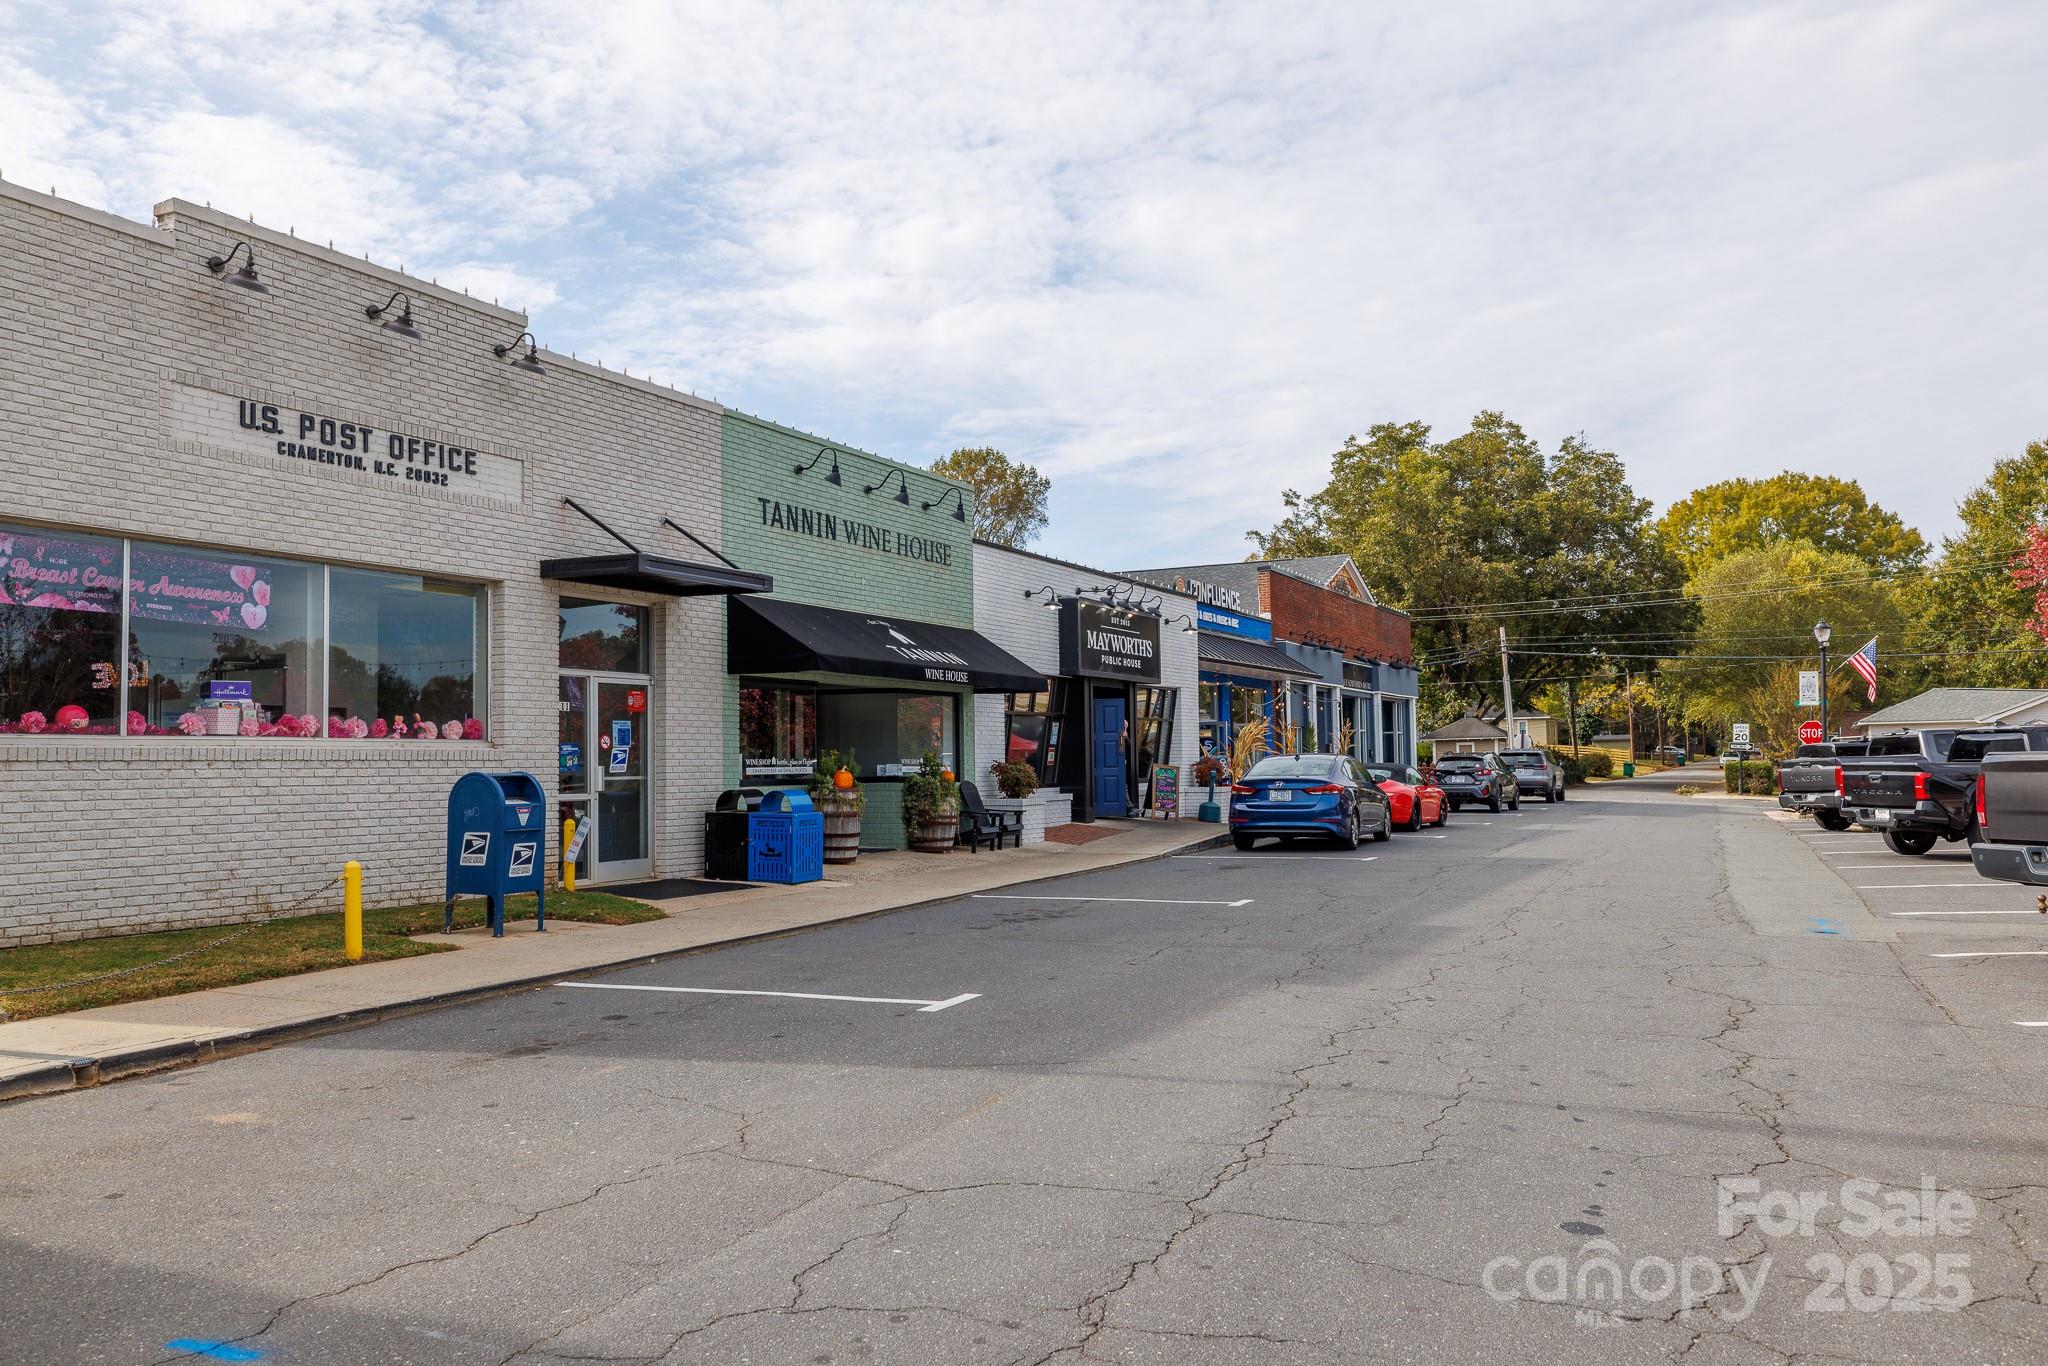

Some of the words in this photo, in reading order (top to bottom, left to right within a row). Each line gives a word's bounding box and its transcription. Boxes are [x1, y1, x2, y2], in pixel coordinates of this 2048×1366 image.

[239, 400, 284, 435] U.S.
[300, 413, 373, 454] POST
[389, 434, 477, 475] OFFICE
[277, 441, 368, 472] CRAMERTON,
[374, 460, 399, 477] N.C.
[406, 466, 449, 487] 28032
[758, 497, 837, 540] TANNIN
[843, 519, 892, 552] WINE
[897, 532, 951, 566] HOUSE
[8, 557, 78, 585] Breast
[148, 575, 245, 604] Awareness
[1087, 629, 1153, 658] MAYWORTH'S
[885, 644, 969, 666] TANNIN
[1101, 654, 1122, 666] PUBLIC
[1123, 657, 1142, 669] HOUSE
[925, 668, 945, 681] WINE
[945, 670, 969, 683] HOUSE
[213, 688, 249, 698] Hallmark
[1735, 733, 1748, 741] 20
[1801, 728, 1823, 738] STOP
[1853, 788, 1902, 796] TACOMA
